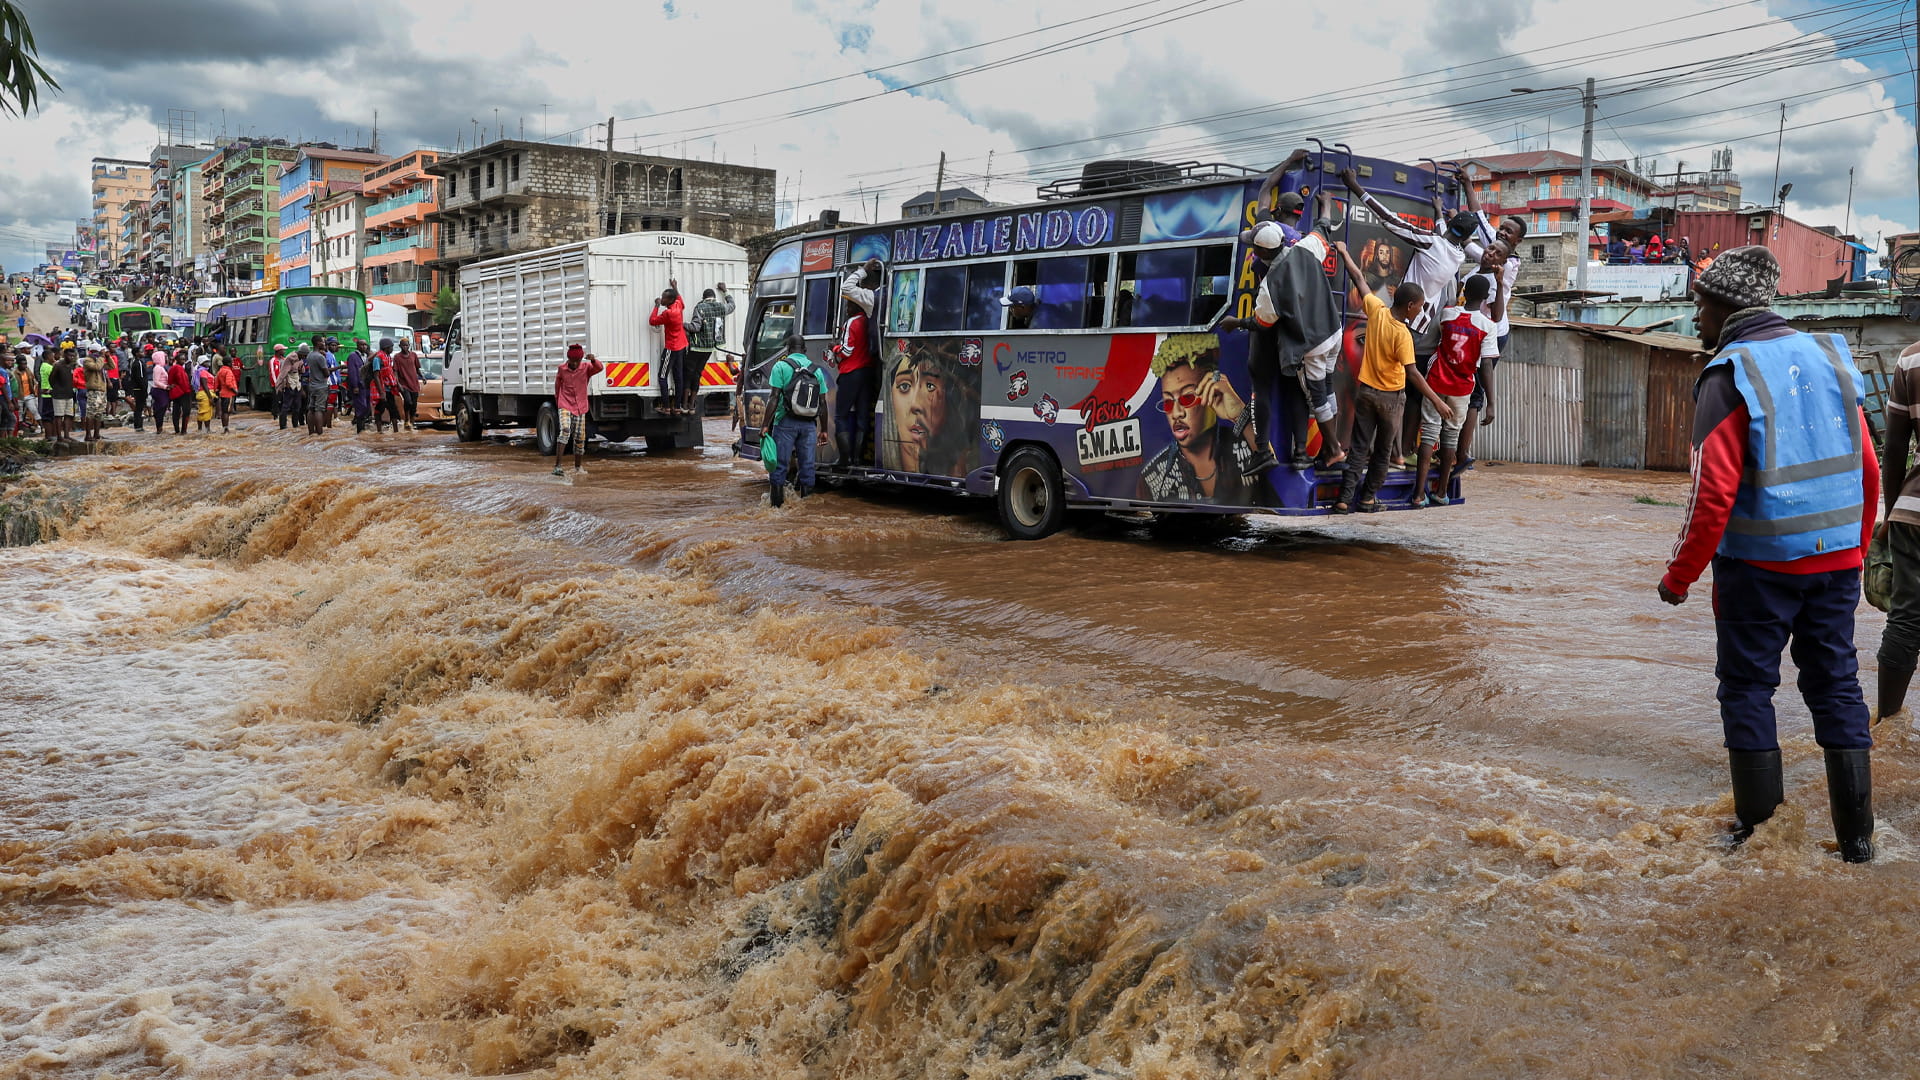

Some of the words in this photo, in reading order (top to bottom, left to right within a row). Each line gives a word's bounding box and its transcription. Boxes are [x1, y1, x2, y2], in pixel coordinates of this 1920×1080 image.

[657, 236, 685, 246] ISUZU
[892, 206, 1108, 263] MZALENDO
[1017, 351, 1066, 364] METRO
[1448, 333, 1469, 365] 3
[1054, 366, 1105, 380] TRANS
[1080, 396, 1131, 433] Jesus
[1079, 425, 1140, 460] S.W.A.G.
